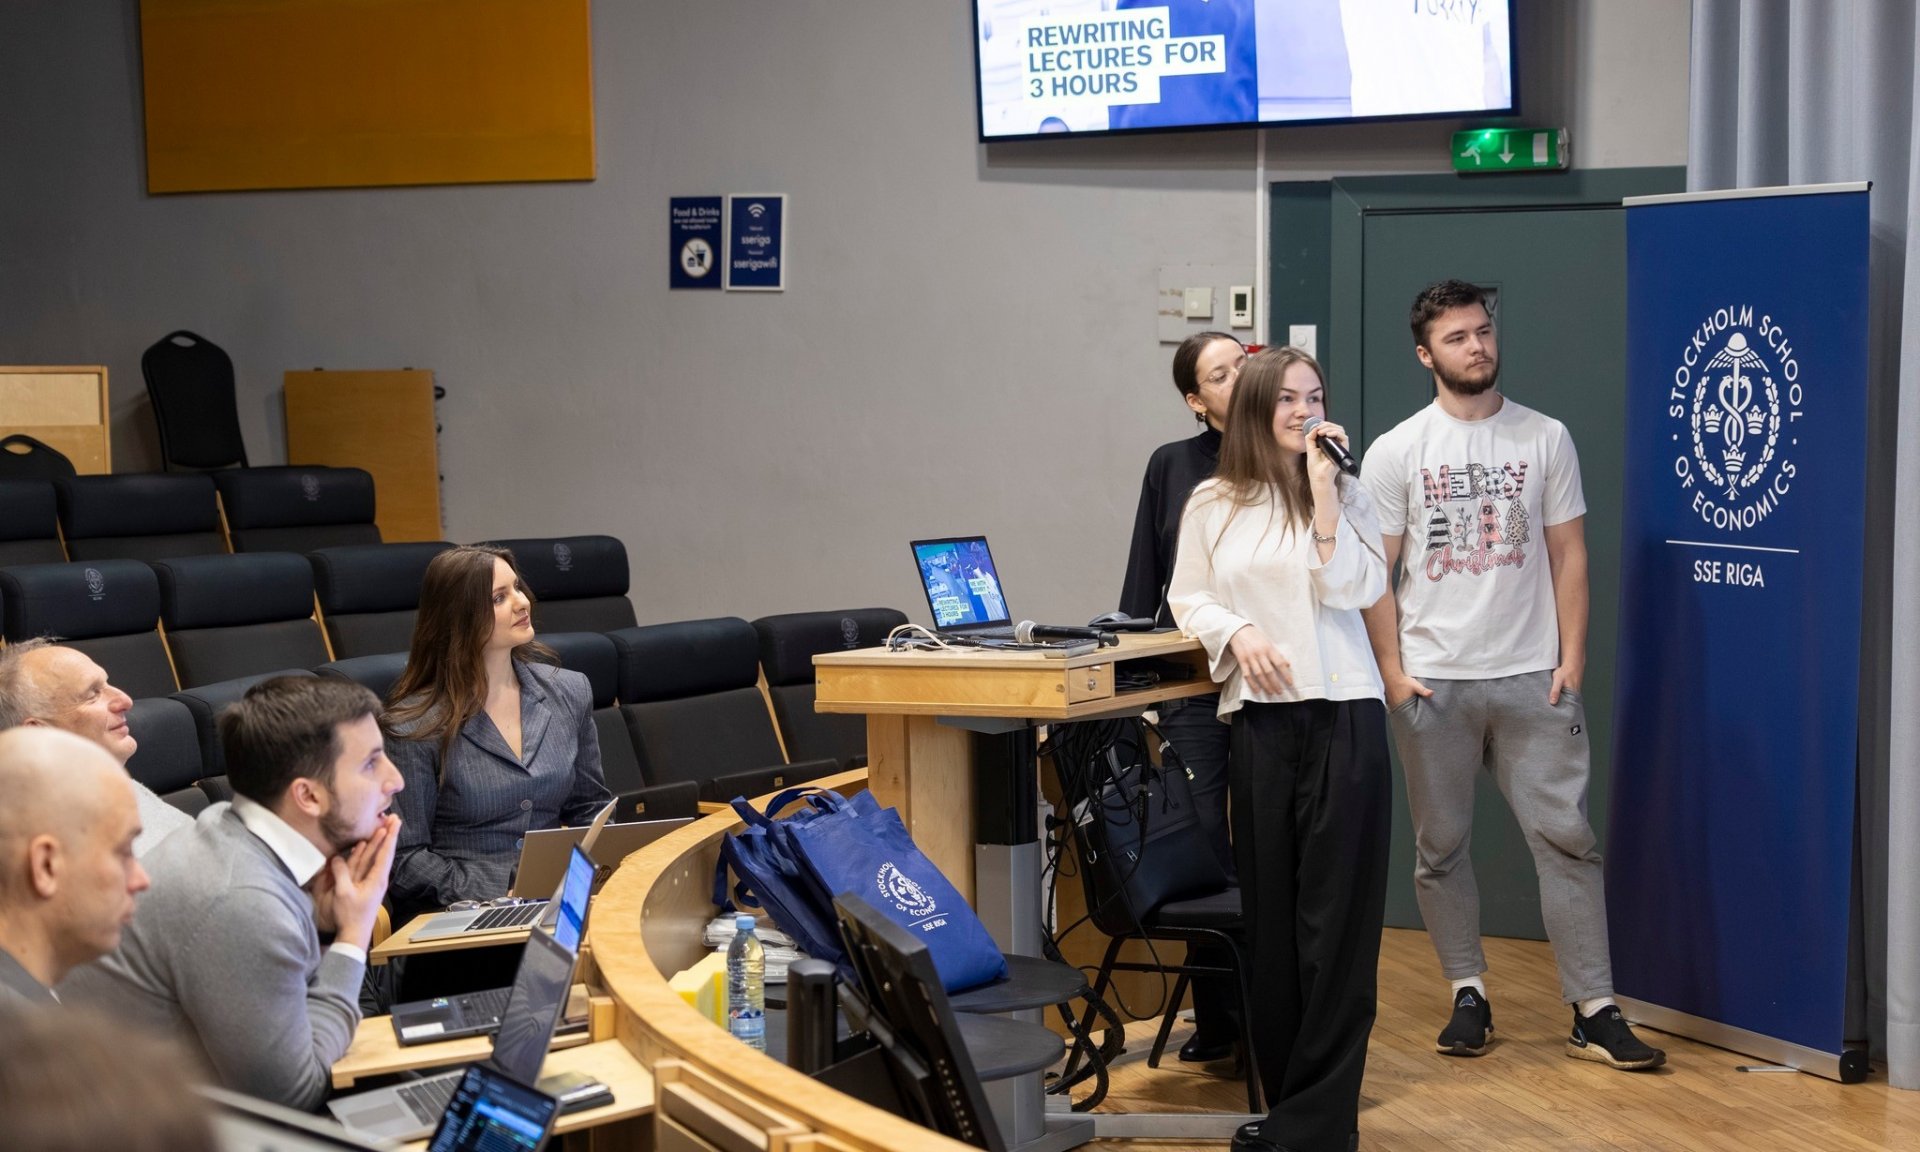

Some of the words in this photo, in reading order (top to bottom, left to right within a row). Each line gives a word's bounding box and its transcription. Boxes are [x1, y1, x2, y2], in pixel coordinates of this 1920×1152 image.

[1028, 18, 1164, 48] REWRITING
[1029, 45, 1153, 73] LECTURES
[1164, 41, 1216, 64] FOR
[1030, 78, 1044, 98] 3
[1051, 72, 1138, 97] HOURS
[673, 208, 690, 216] Food
[691, 208, 698, 216] &
[699, 208, 719, 216] Drinks
[1669, 304, 1754, 419] STOCKHOLM
[1759, 315, 1803, 423] SCHOOL
[1420, 460, 1528, 509] MERRY
[1675, 455, 1695, 489] OF
[1692, 459, 1796, 531] ECONOMICS
[1426, 541, 1526, 582] Christmas
[1693, 560, 1721, 584] SSE
[1726, 562, 1765, 588] RIGA
[922, 922, 935, 932] SSE
